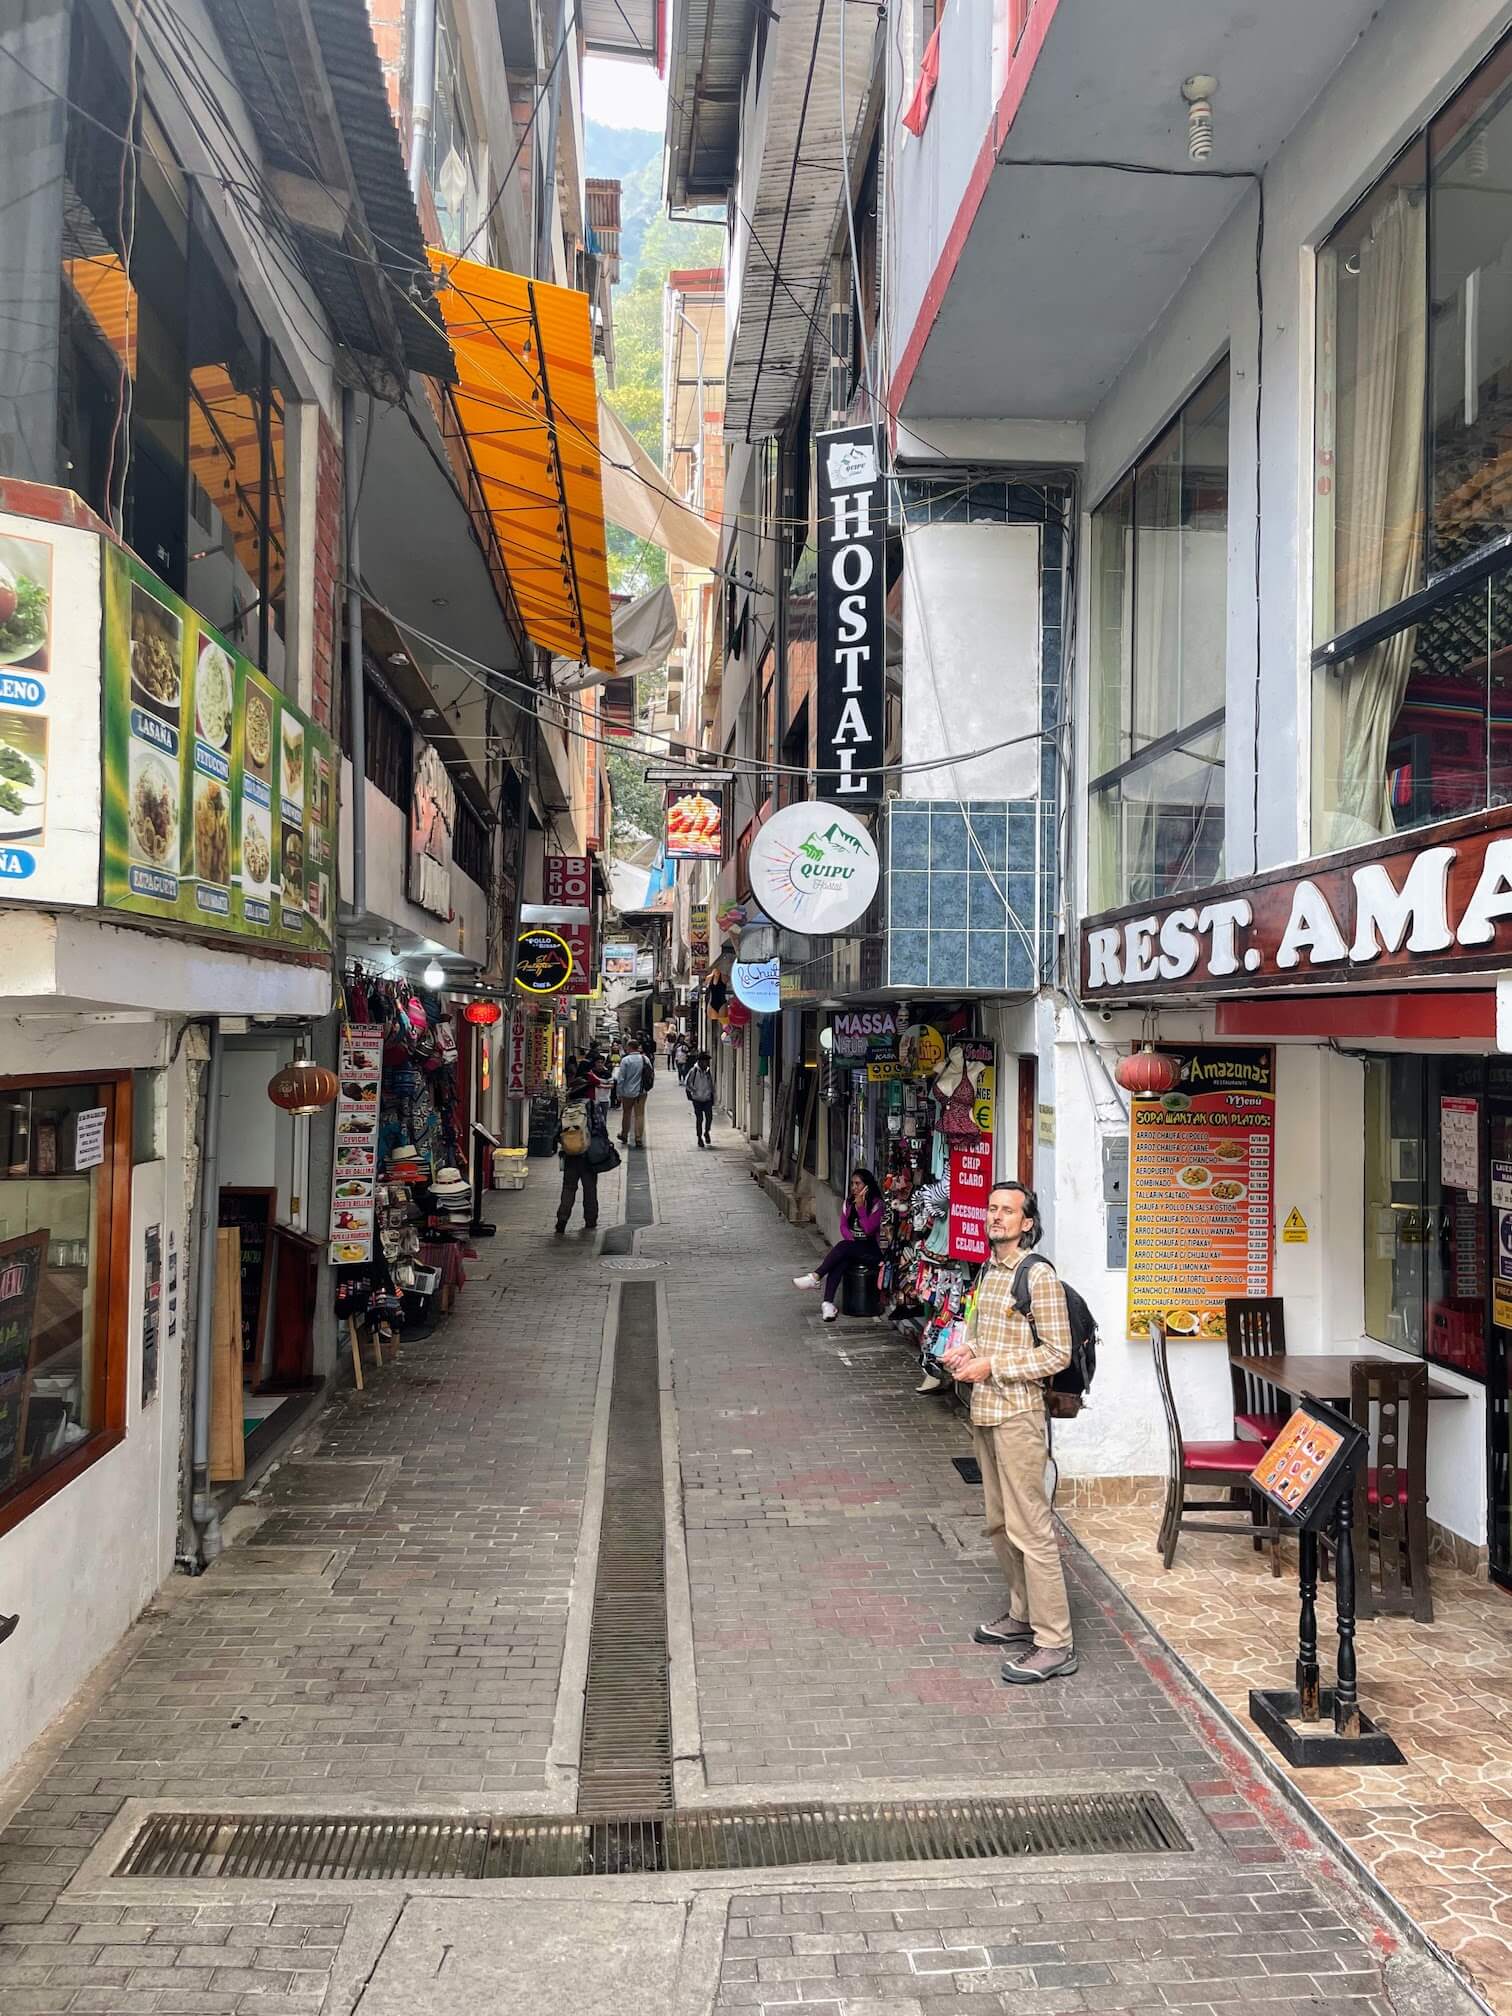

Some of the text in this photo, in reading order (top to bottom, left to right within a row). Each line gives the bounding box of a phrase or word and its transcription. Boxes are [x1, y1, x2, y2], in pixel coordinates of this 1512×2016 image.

[830, 490, 874, 794] HOSTAL
[136, 714, 172, 748] LASAÑA
[800, 863, 856, 879] QUIPU
[1087, 898, 1261, 989] REST.
[1191, 1056, 1269, 1084] Amazonas
[1136, 1111, 1271, 1127] SOPA WANTAN CON PLATOS:
[970, 1142, 990, 1155] CARD
[962, 1156, 980, 1170] CHIP
[959, 1172, 983, 1188] CLARO
[962, 1222, 980, 1236] PARA
[956, 1237, 984, 1254] CELULAR
